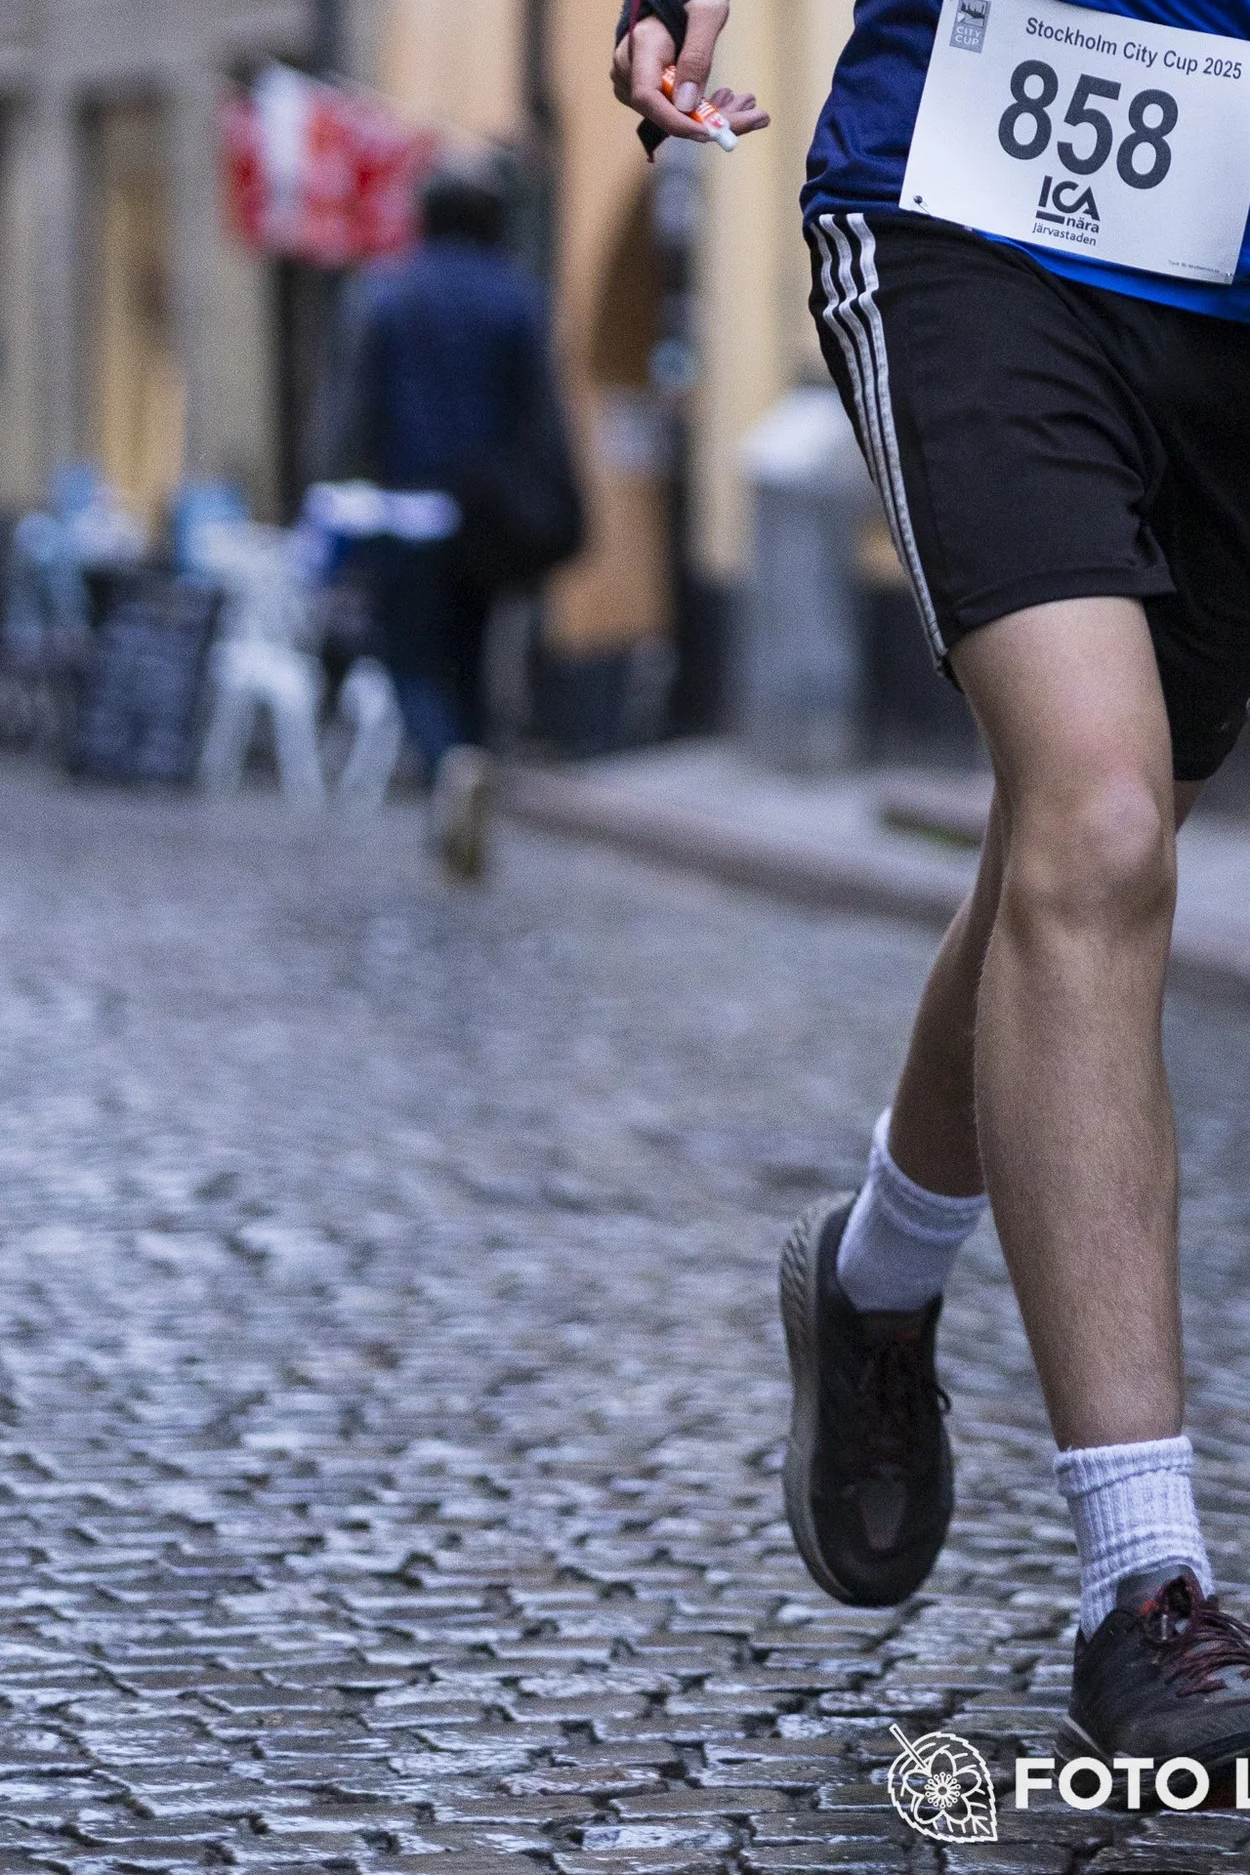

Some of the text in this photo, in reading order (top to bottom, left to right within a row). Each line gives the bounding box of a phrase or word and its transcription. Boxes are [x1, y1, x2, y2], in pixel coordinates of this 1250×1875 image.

[955, 34, 980, 45] CUP
[956, 25, 982, 38] CITY
[1025, 17, 1242, 80] Stockholm City Cup 2025
[998, 59, 1179, 190] 858
[1038, 175, 1101, 222] ICA
[1066, 216, 1100, 234] nära
